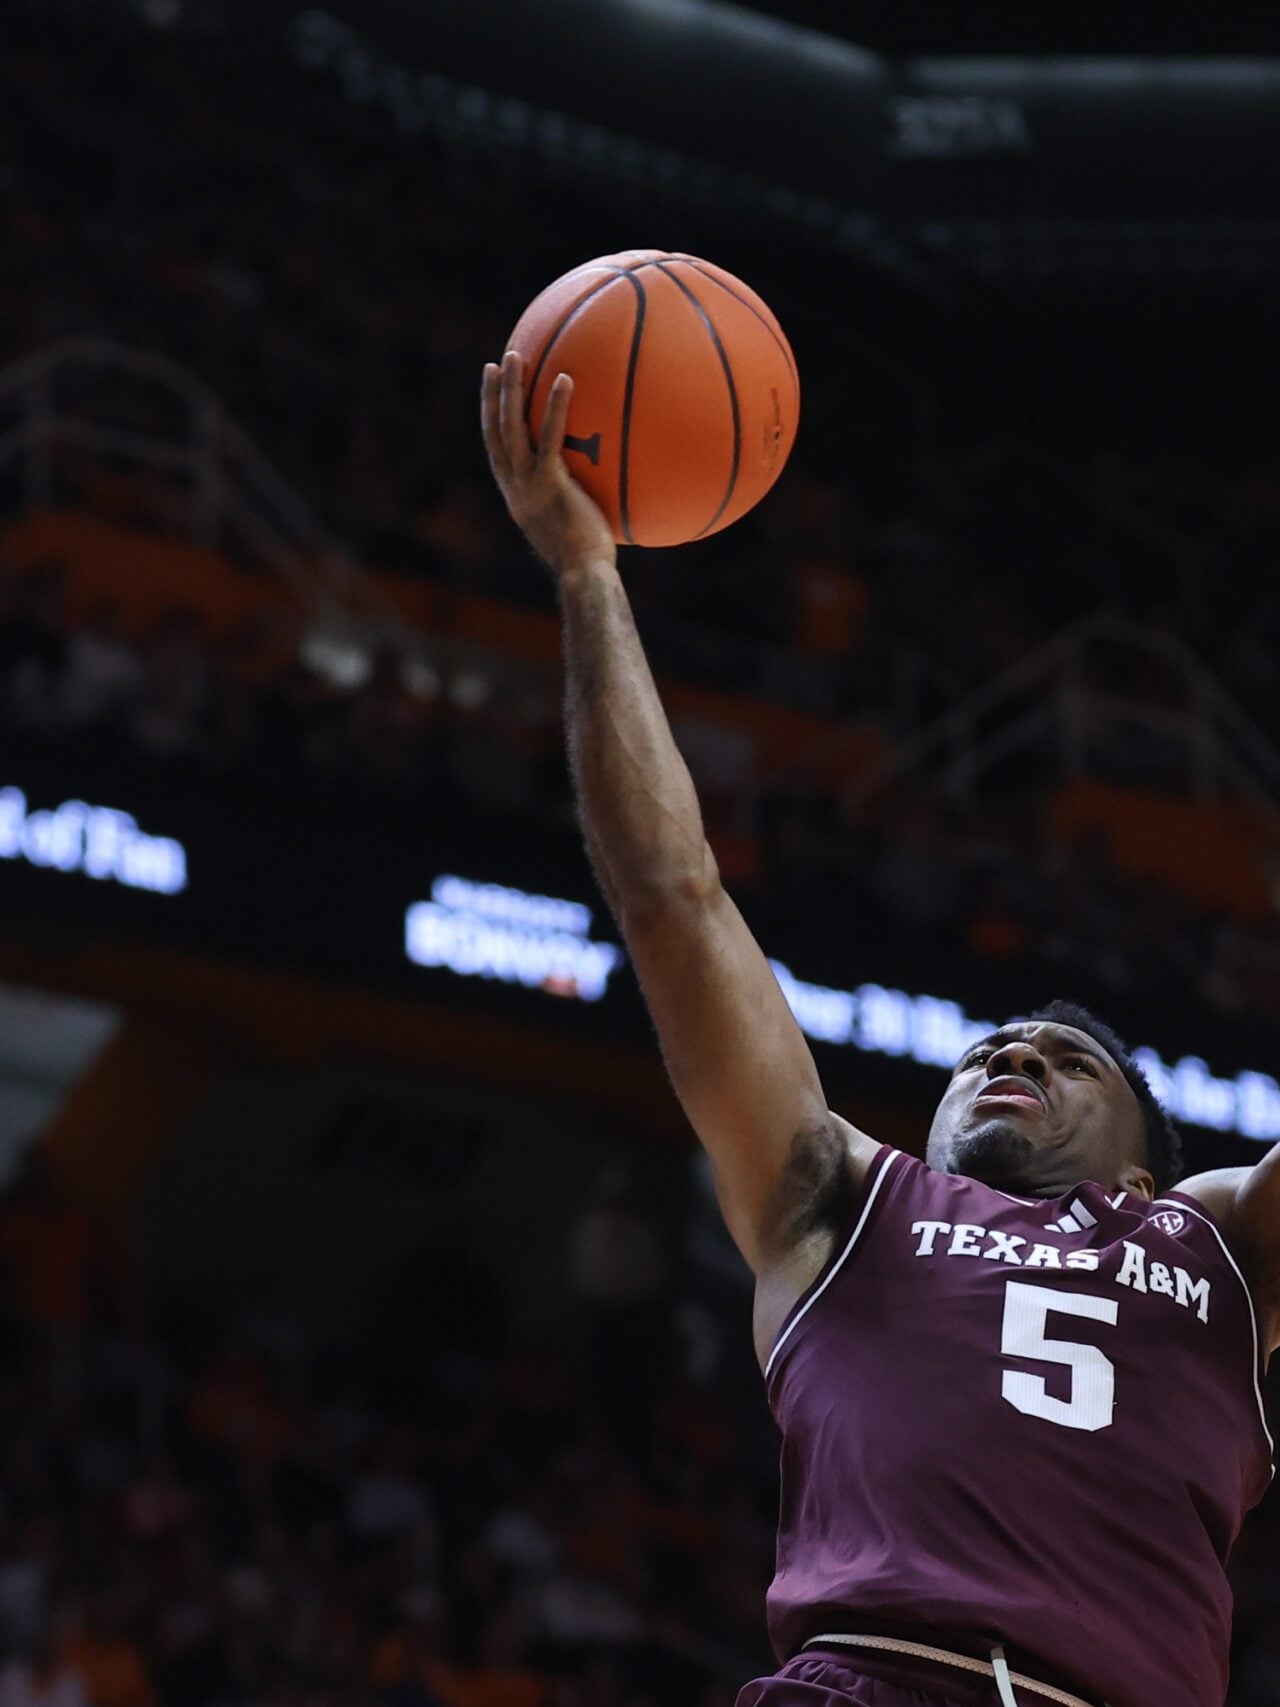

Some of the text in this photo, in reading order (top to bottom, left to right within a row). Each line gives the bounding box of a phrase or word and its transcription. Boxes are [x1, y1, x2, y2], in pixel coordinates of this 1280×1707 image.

[911, 1220, 1211, 1324] TEXAS A&M
[1000, 1280, 1119, 1432] 5
